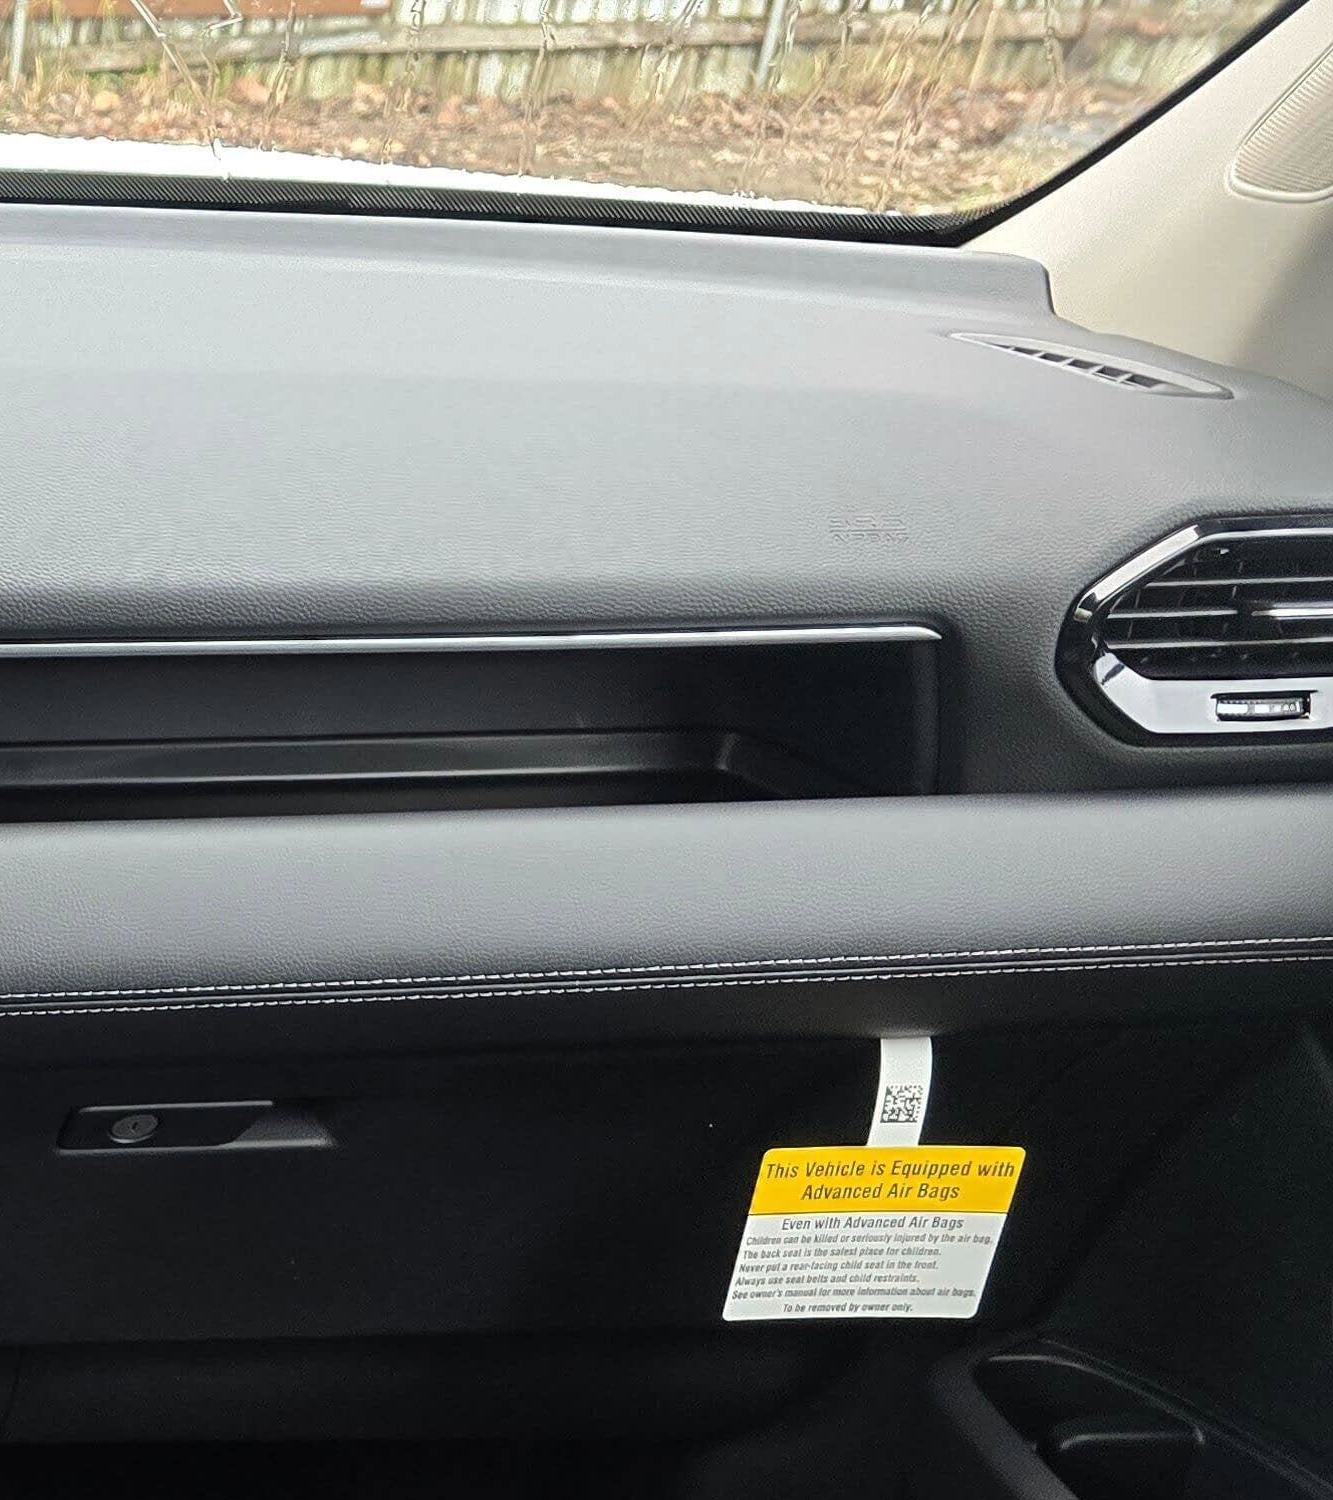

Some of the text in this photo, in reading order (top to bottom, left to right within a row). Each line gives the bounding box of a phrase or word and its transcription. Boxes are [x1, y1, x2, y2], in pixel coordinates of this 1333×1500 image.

[766, 1160, 1015, 1179] This Vehicle is Equipped with
[802, 1183, 960, 1201] Advanced Air Bags
[782, 1216, 965, 1231] Even with Advanced Air Bags
[746, 1236, 781, 1246] Children
[801, 1234, 811, 1243] be
[813, 1234, 837, 1243] killed
[840, 1235, 850, 1243] or
[851, 1233, 892, 1243] seriously
[893, 1233, 926, 1243] injured
[928, 1233, 939, 1243] by
[941, 1234, 955, 1242] the
[957, 1234, 971, 1243] air
[972, 1234, 993, 1244] bag.
[743, 1247, 941, 1259] The back seat the safest place for children.
[739, 1260, 938, 1273] Never put rear-facing child seat the front.
[734, 1274, 920, 1287] Always use seat belts and child restraints.
[732, 1288, 976, 1299] See owner's manual for more information about air bags.
[783, 1302, 913, 1312] To be removed by owner only.
